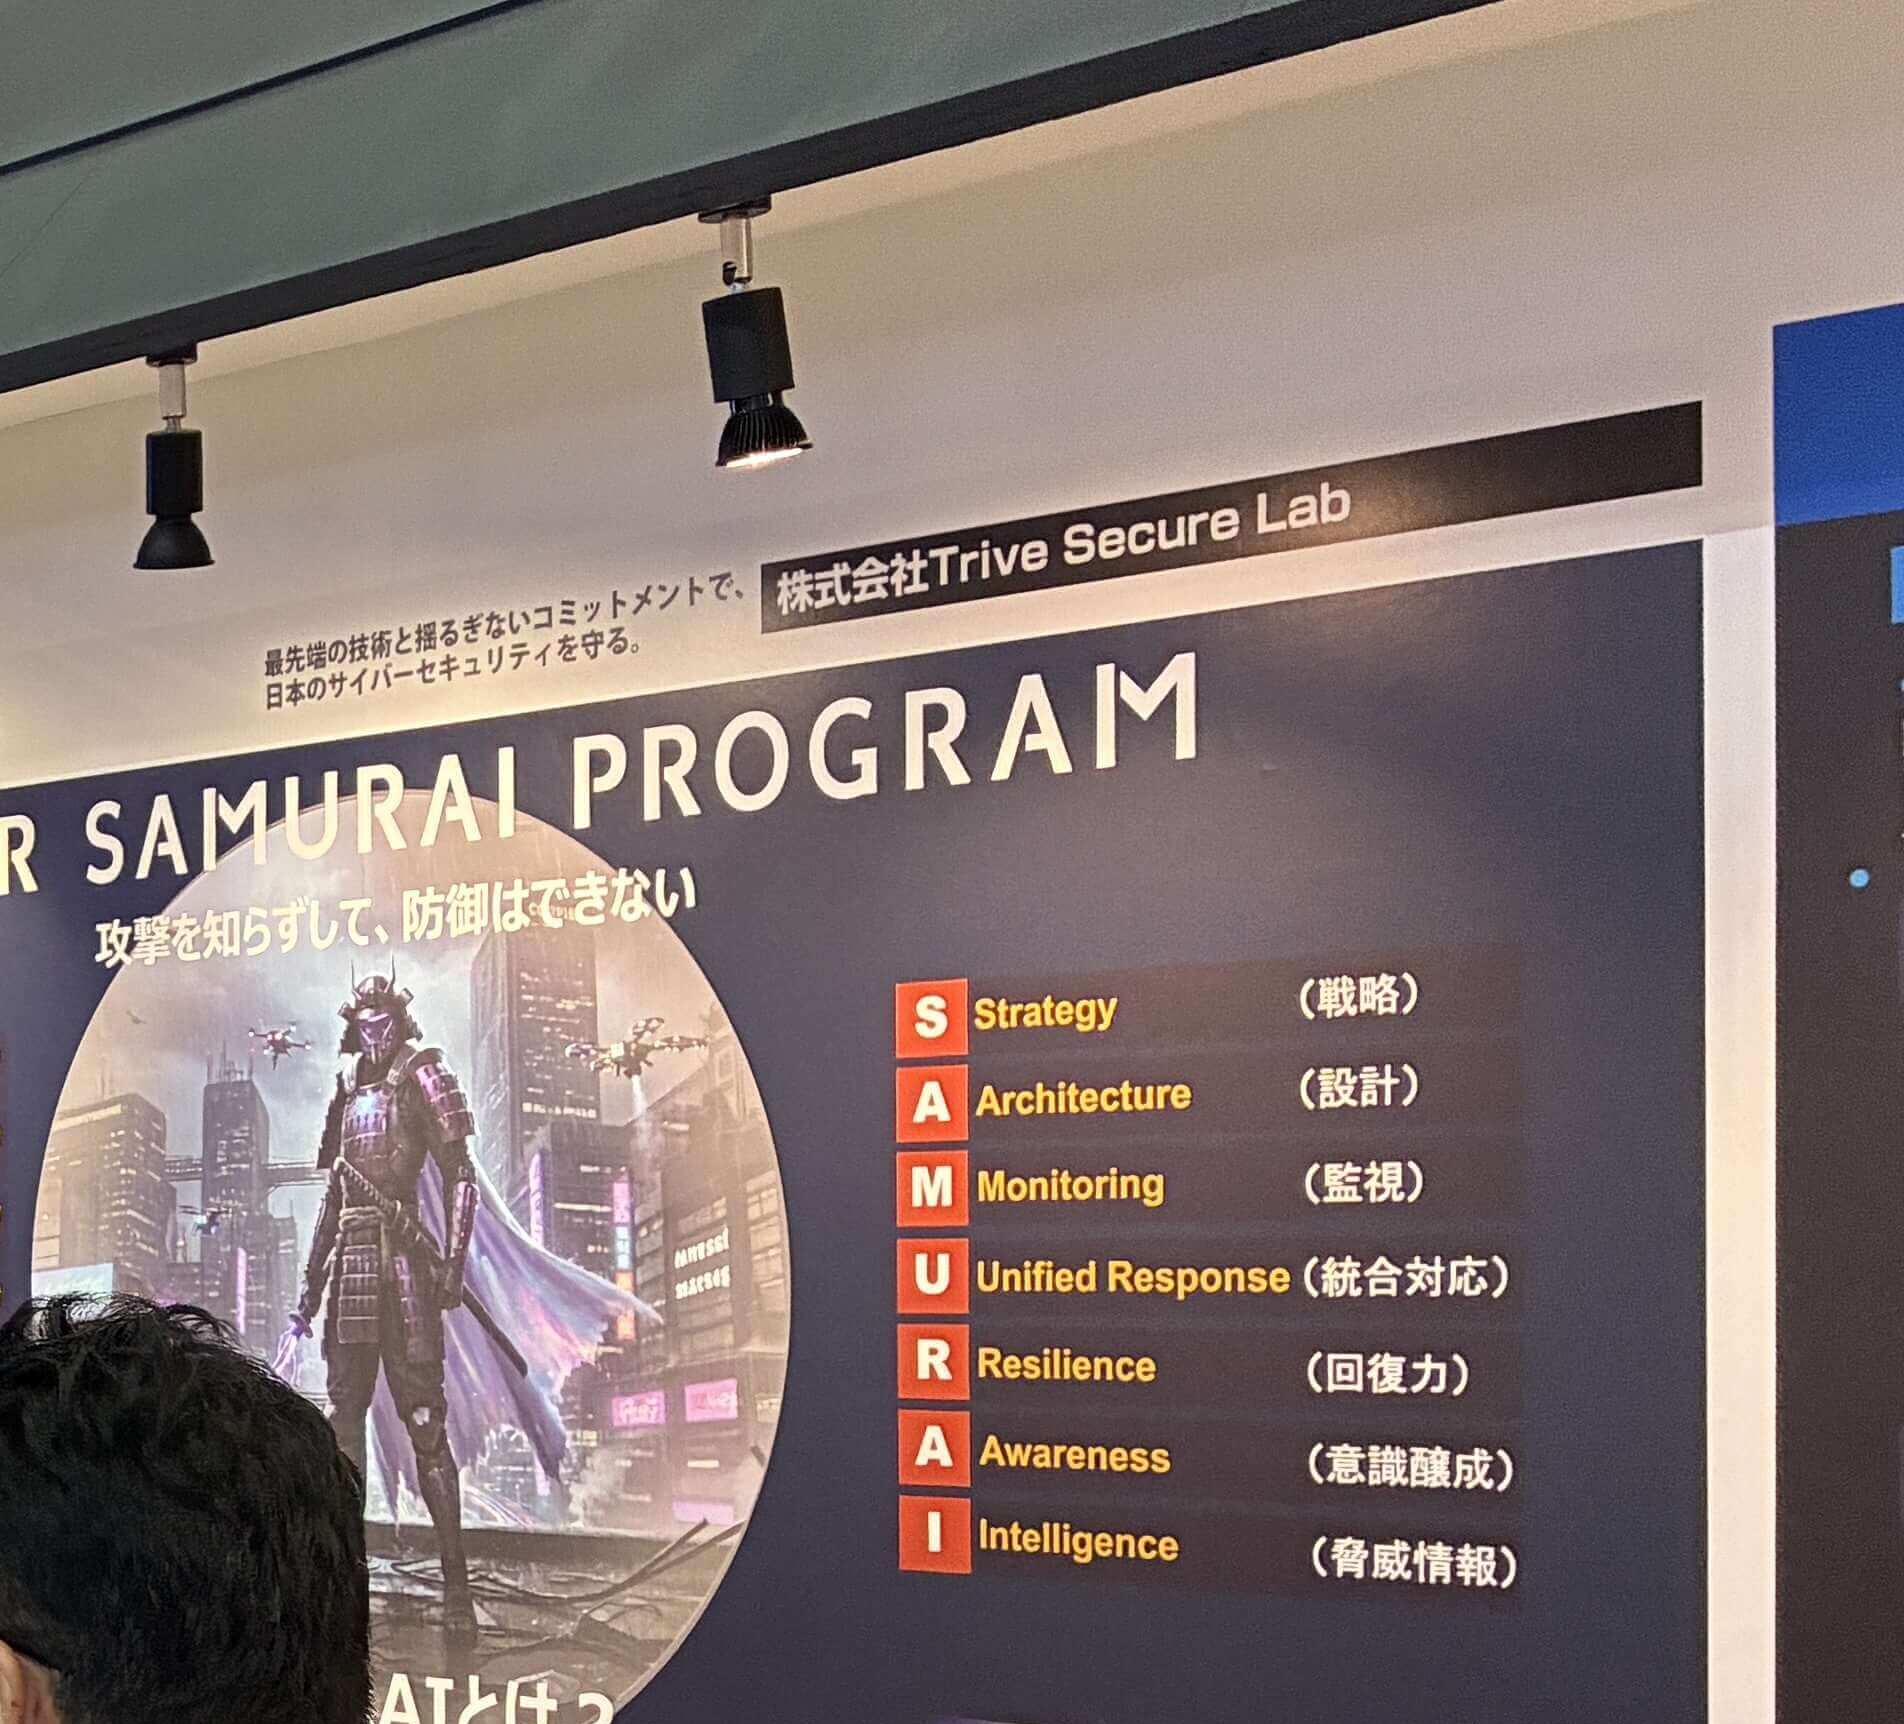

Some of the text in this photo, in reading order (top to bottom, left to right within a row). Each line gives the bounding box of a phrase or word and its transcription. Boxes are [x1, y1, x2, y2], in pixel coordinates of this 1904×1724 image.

[776, 482, 1350, 616] 株式会社Trive Secure Lab
[264, 571, 745, 677] 最先端の技術と揺るぎないコミットメントで、
[264, 629, 643, 710] 日本のサイバーセキュリティを守る。
[86, 745, 514, 885] SAMURAI
[572, 651, 1198, 829] PROGRAM
[95, 864, 696, 969] 攻撃を知らずして、防御はできない
[914, 973, 1418, 1038] S Strategy （戦略）
[912, 1065, 1419, 1122] A Architecture （設計）
[911, 1160, 1424, 1207] M Monitoring （監視）
[914, 1253, 1509, 1300] U Unified Response （統合対応）
[917, 1340, 1469, 1395] R Resilience （回復力）
[914, 1425, 1514, 1492] A Awareness （意識醸成）
[927, 1511, 1517, 1589] I Intelligence （脅威情報）
